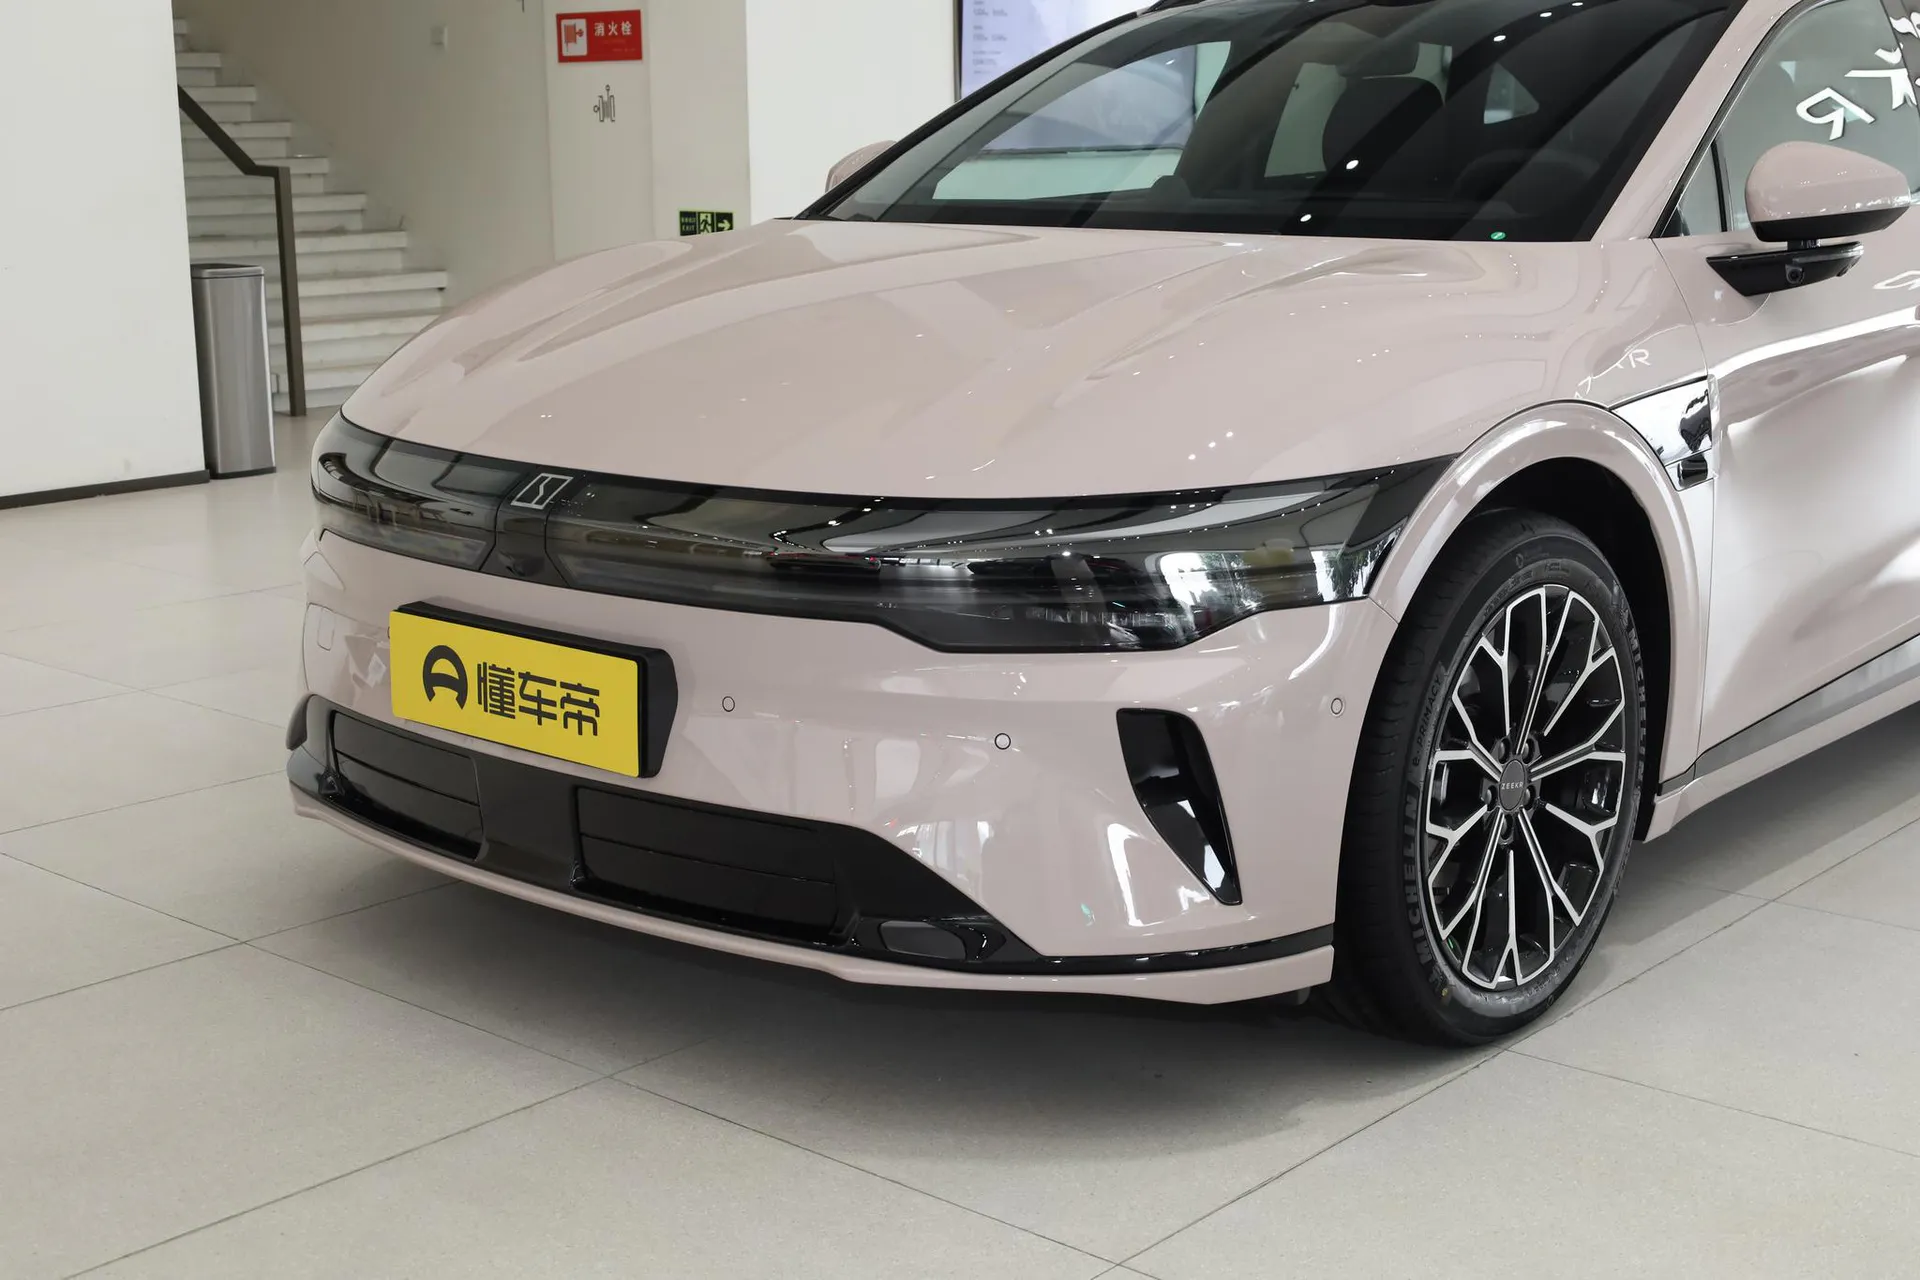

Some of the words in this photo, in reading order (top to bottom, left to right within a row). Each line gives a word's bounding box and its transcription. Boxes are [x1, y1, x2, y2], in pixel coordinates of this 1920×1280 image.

[594, 21, 632, 37] 消火栓
[477, 662, 600, 736] 懂车帝
[1628, 628, 1646, 780] MICHELIN
[1501, 781, 1524, 790] ZEEKR
[1404, 794, 1433, 966] MICHELIN
